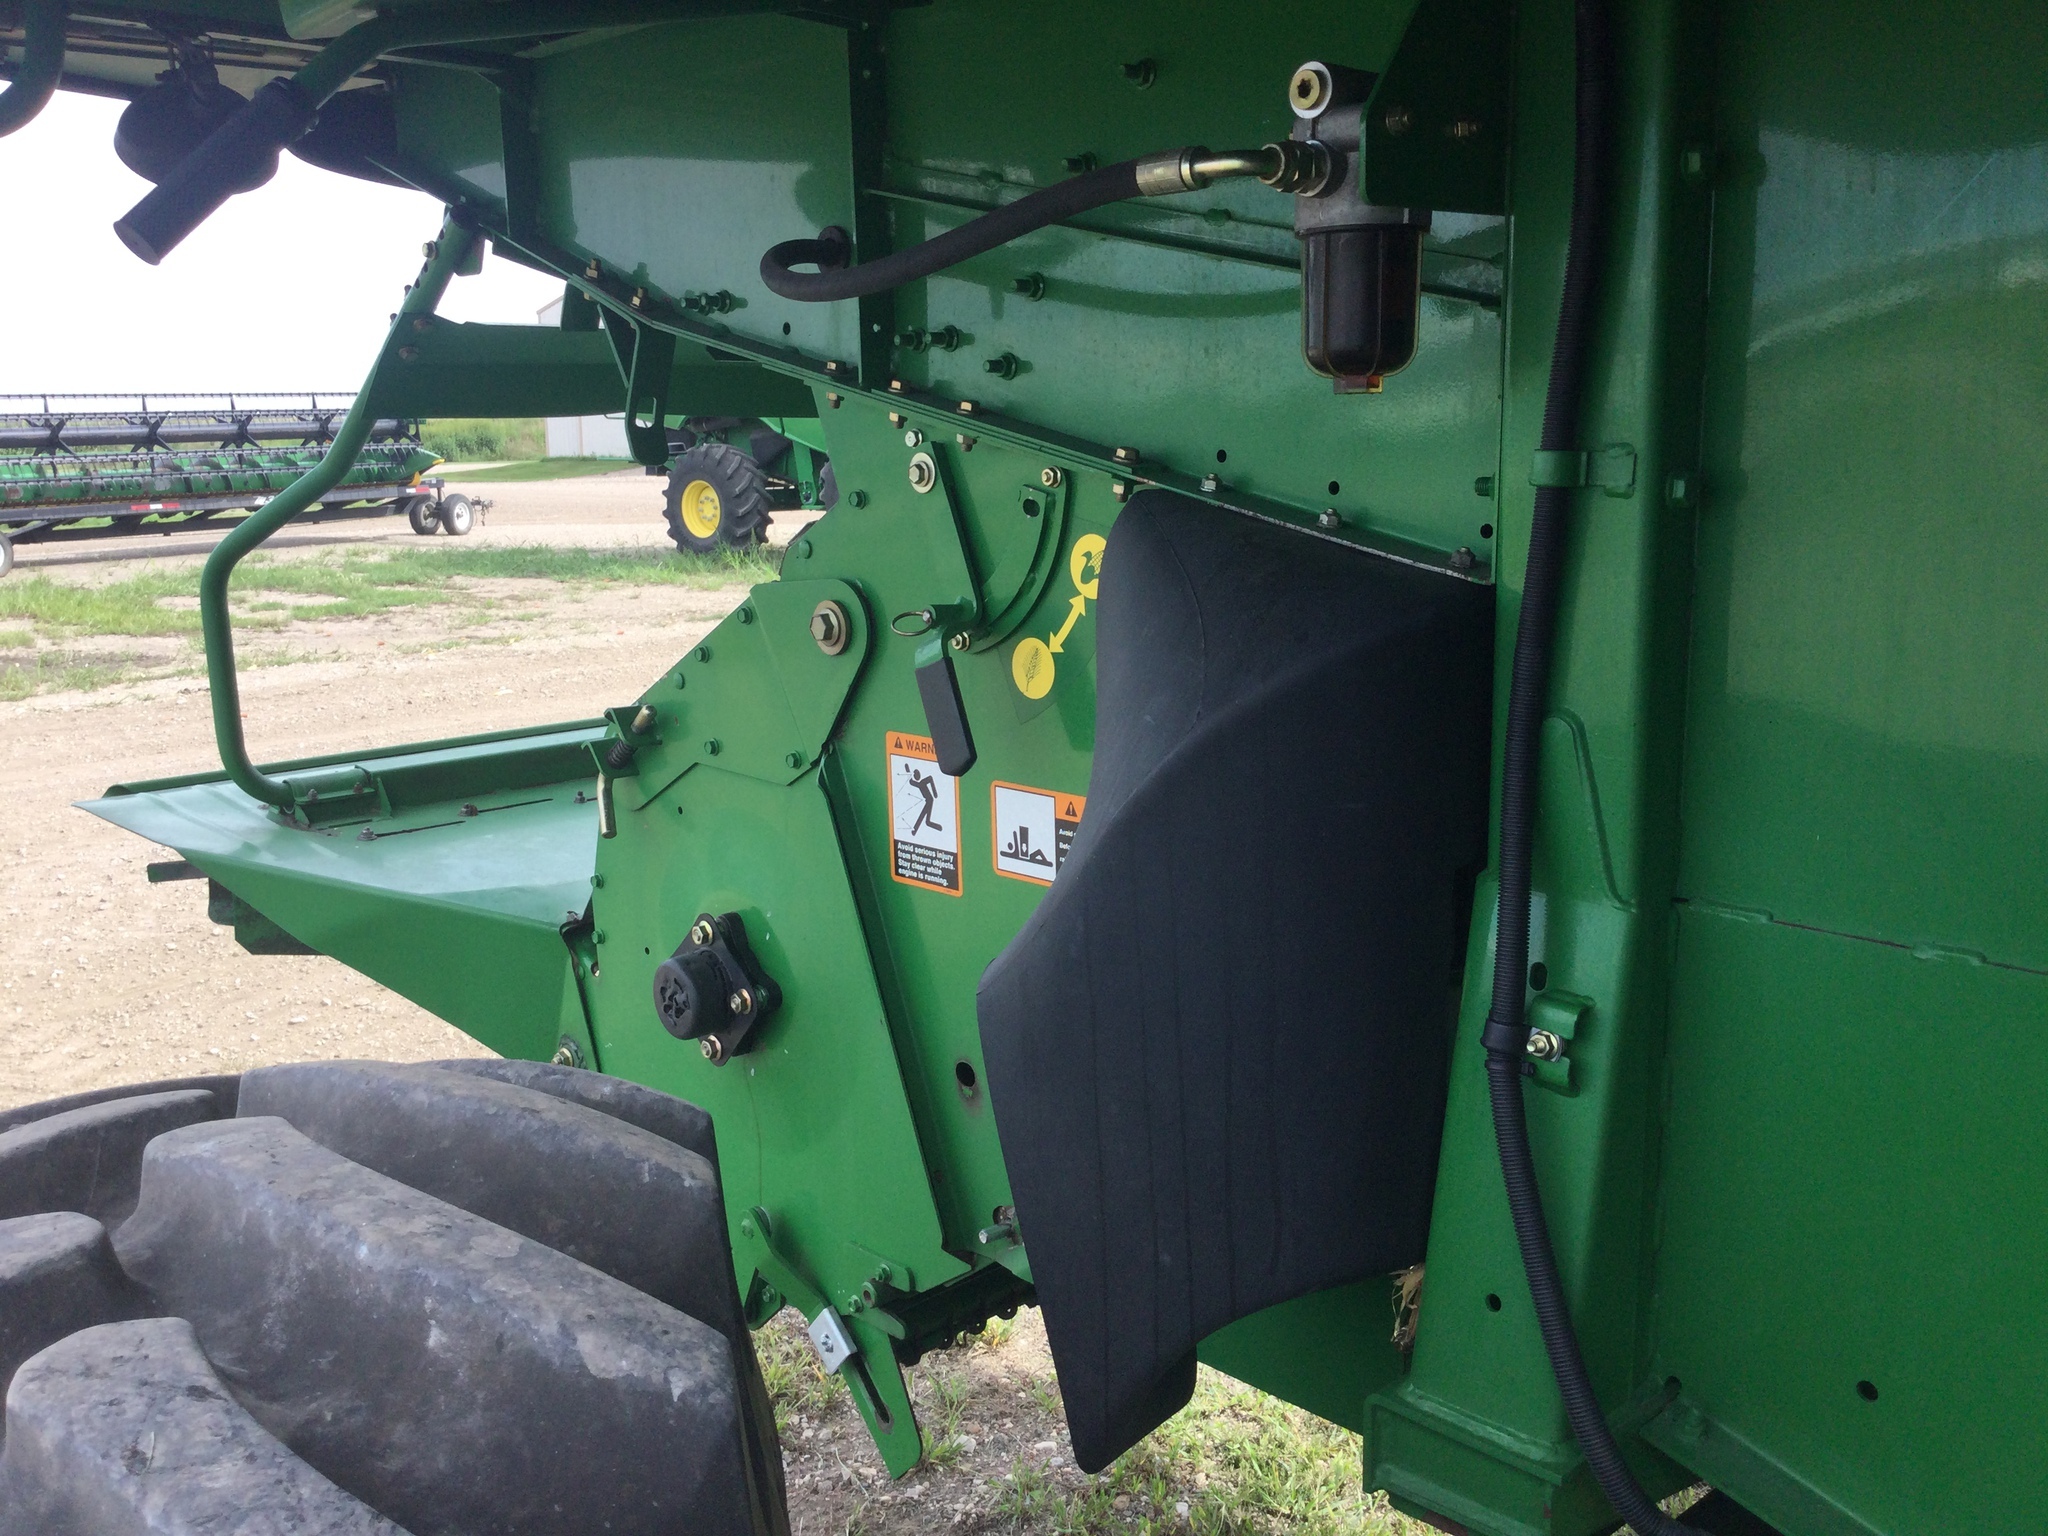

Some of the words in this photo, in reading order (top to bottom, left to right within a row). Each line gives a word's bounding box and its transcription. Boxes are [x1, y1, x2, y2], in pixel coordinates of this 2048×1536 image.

[906, 739, 934, 754] WARN
[898, 842, 914, 852] Avoid
[915, 847, 936, 857] serious
[937, 851, 954, 862] injury
[898, 851, 911, 860] from
[912, 853, 932, 864] thrown
[932, 860, 955, 870] objects.
[898, 858, 911, 869] Stay
[911, 862, 925, 871] clear
[927, 866, 942, 875] while
[898, 868, 918, 877] engine
[918, 871, 923, 879] is
[925, 875, 949, 886] running.
